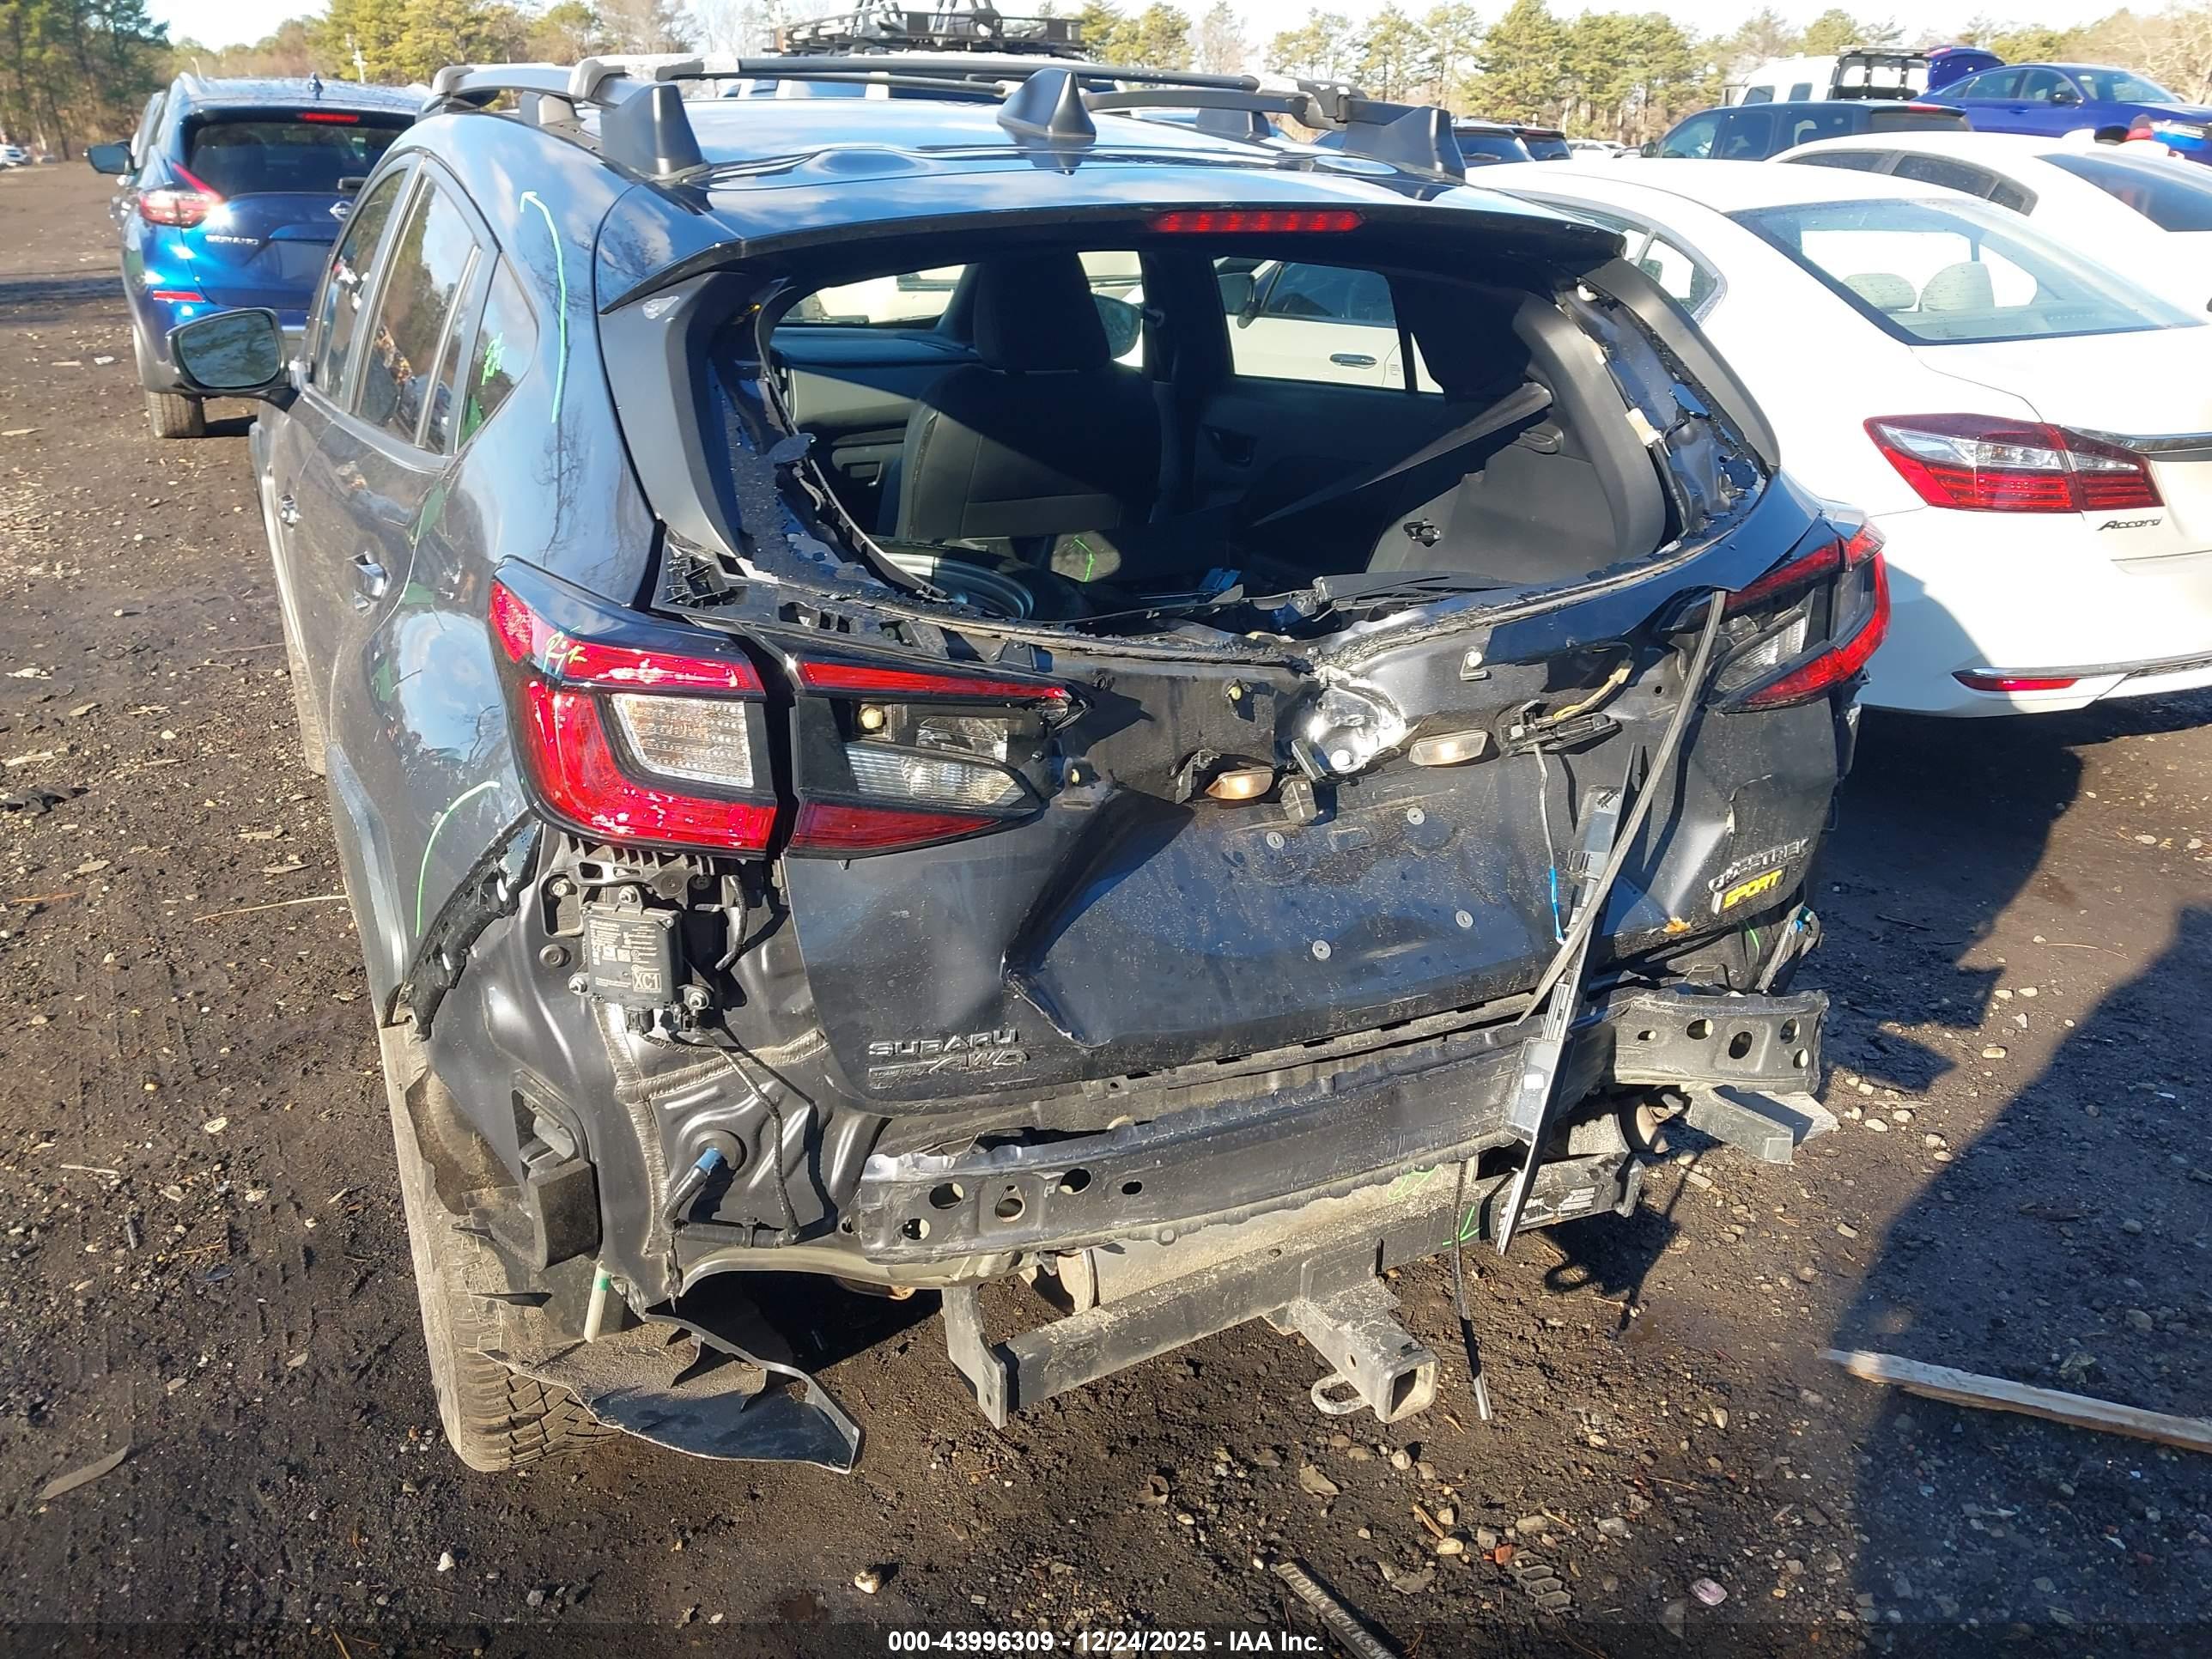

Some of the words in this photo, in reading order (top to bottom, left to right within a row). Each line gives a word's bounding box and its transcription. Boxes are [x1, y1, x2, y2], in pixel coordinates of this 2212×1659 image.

[2096, 516, 2163, 531] Accord
[1723, 869, 1784, 908] SPORT
[869, 1029, 1020, 1056] SUBARU
